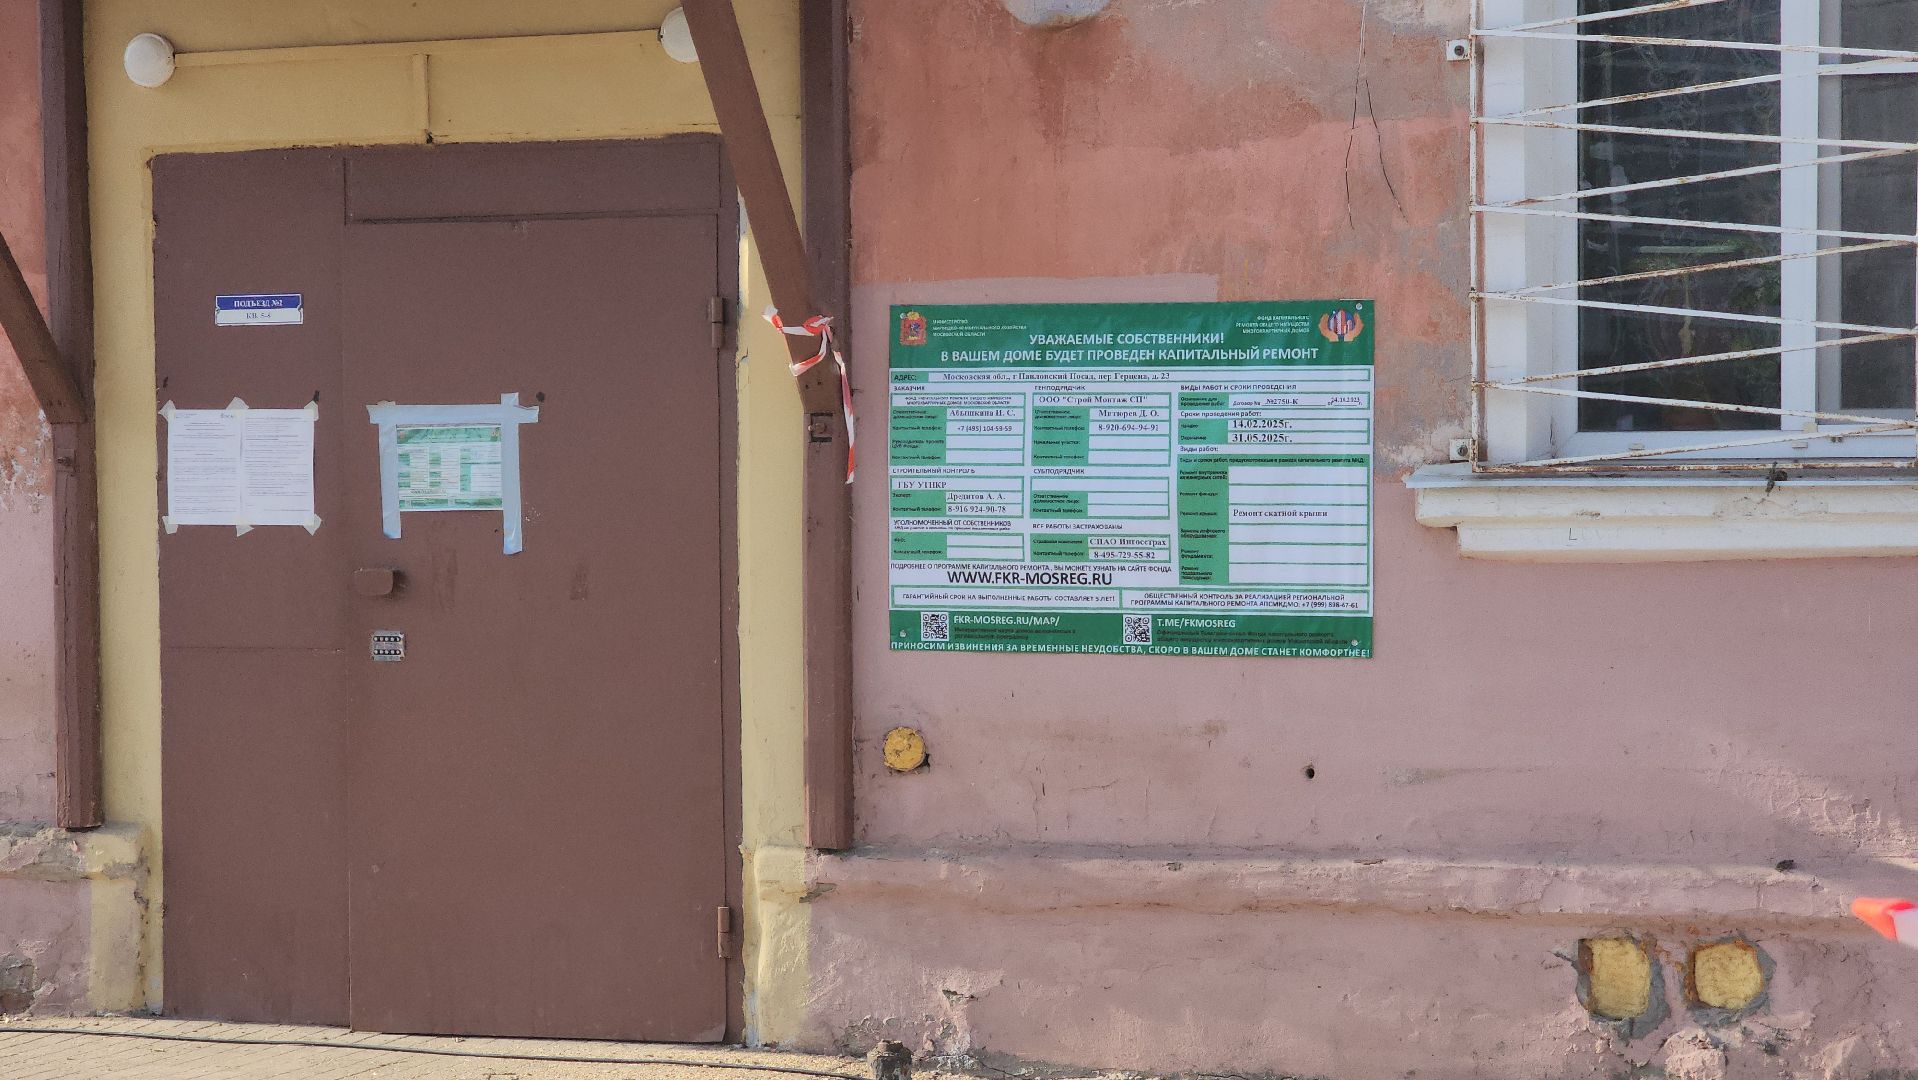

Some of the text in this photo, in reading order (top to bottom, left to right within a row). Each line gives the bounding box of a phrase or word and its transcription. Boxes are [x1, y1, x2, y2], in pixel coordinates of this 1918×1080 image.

[234, 300, 270, 308] ПОДЪЕЗД
[1029, 333, 1224, 345] УВАЖАЕМЫЕ СОБСТВЕННИКИ!
[941, 346, 1318, 363] В ВАШЕМ ДОМЕ БУДЕТ ПРОВЕДЕН КАПИТАЛЬНЫЙ РЕМОНТ
[894, 374, 917, 382] АДРЕС:
[1019, 372, 1067, 380] Павловский
[1161, 372, 1170, 380] 23
[1241, 410, 1262, 418] работ:
[1233, 419, 1293, 428] 14.02.2025г.
[1232, 433, 1293, 442] 31.05.2025г.
[1233, 509, 1328, 518] Ремонт скатной крыши
[1119, 539, 1167, 547] Ингосстрах
[1094, 551, 1155, 559] 8-495-729-55-82
[1127, 564, 1147, 572] САЙТЕ
[947, 571, 1113, 585] WWW.FKR-MOSREG.RU
[953, 616, 1060, 627] FKR-MOSREG.RU/MAP/
[1157, 618, 1236, 629] T.ME/FKMOSREG
[891, 641, 1370, 657] ПРИНОСИМ ИЗВИНЕНИЯ ЗА ВРЕМЕННЫЕ НЕУДОБСТВА, СКОРО В ВАШЕМ ДОМЕ СТАНЕТ КОМФОРТНЕЕ!
